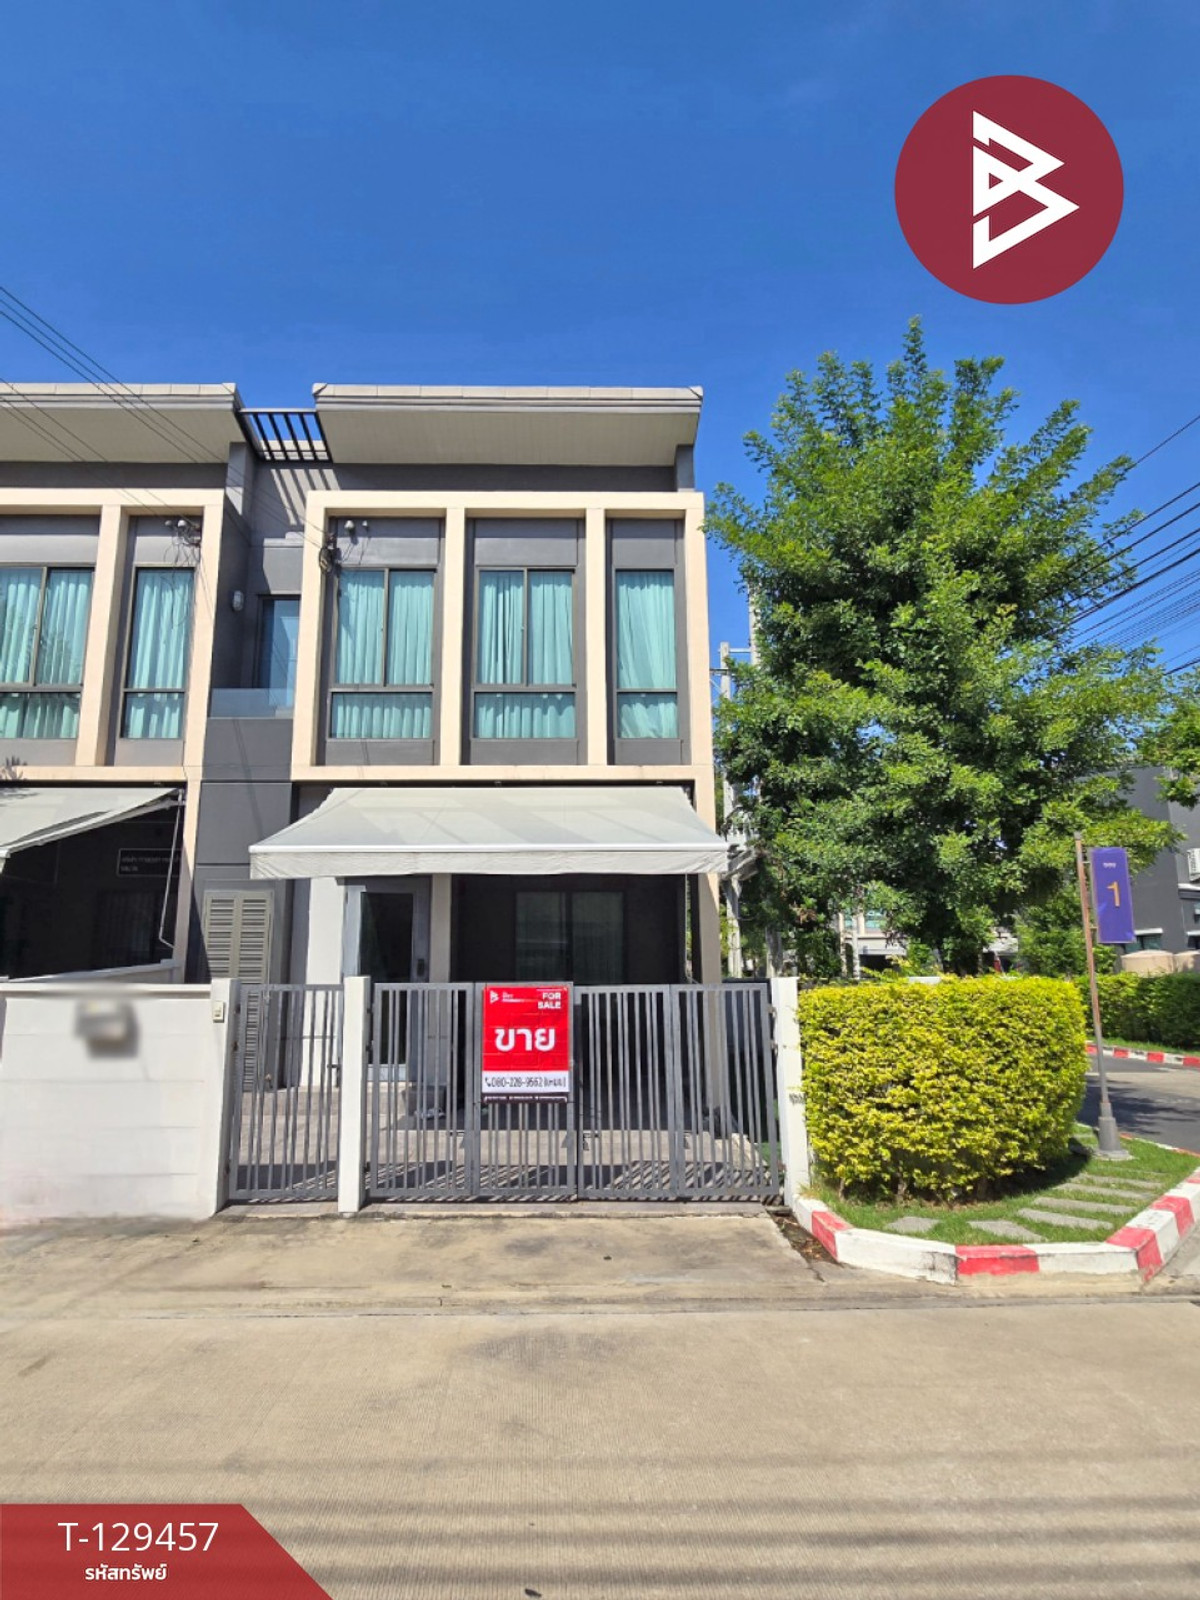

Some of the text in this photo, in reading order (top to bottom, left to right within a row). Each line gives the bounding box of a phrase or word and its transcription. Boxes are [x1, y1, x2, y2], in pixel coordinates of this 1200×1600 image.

[1106, 881, 1120, 907] 1
[542, 992, 561, 1000] FOR
[537, 1001, 561, 1009] SALE
[494, 1028, 556, 1052] ขาย
